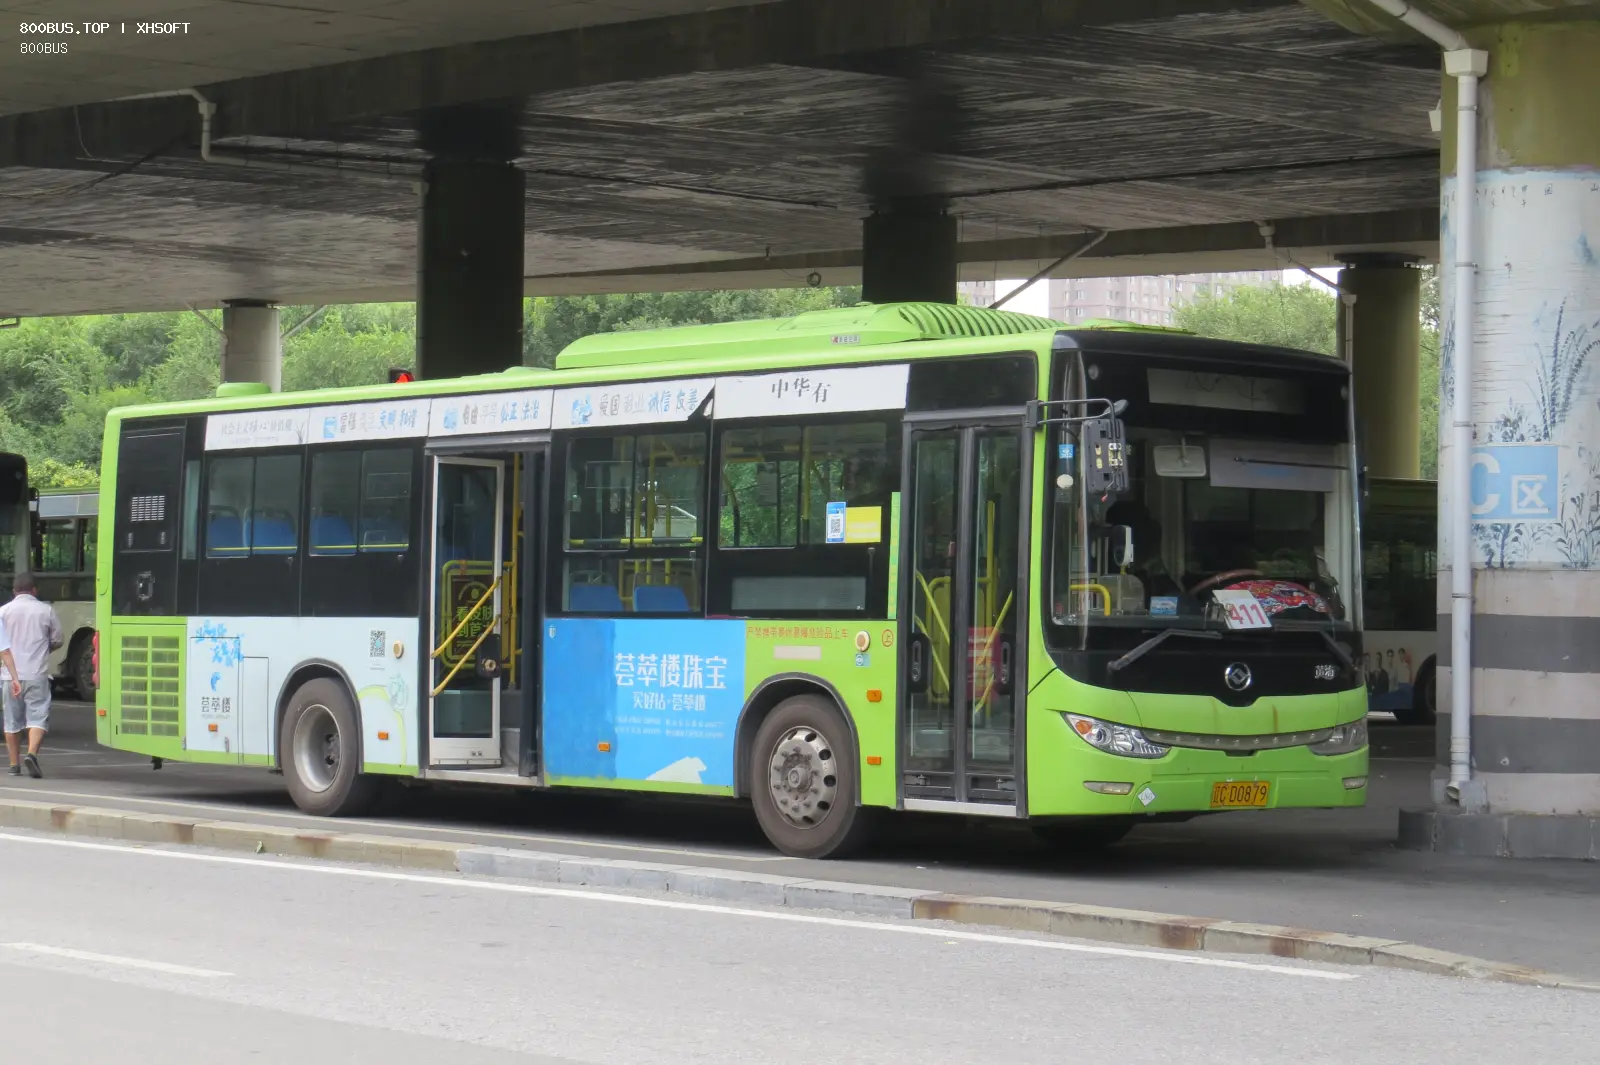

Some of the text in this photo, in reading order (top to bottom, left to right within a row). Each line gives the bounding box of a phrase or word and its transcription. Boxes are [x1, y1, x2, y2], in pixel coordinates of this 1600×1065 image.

[1470, 452, 1549, 514] C区
[1226, 603, 1266, 624] 411
[615, 652, 727, 689] 荟萃楼珠宝
